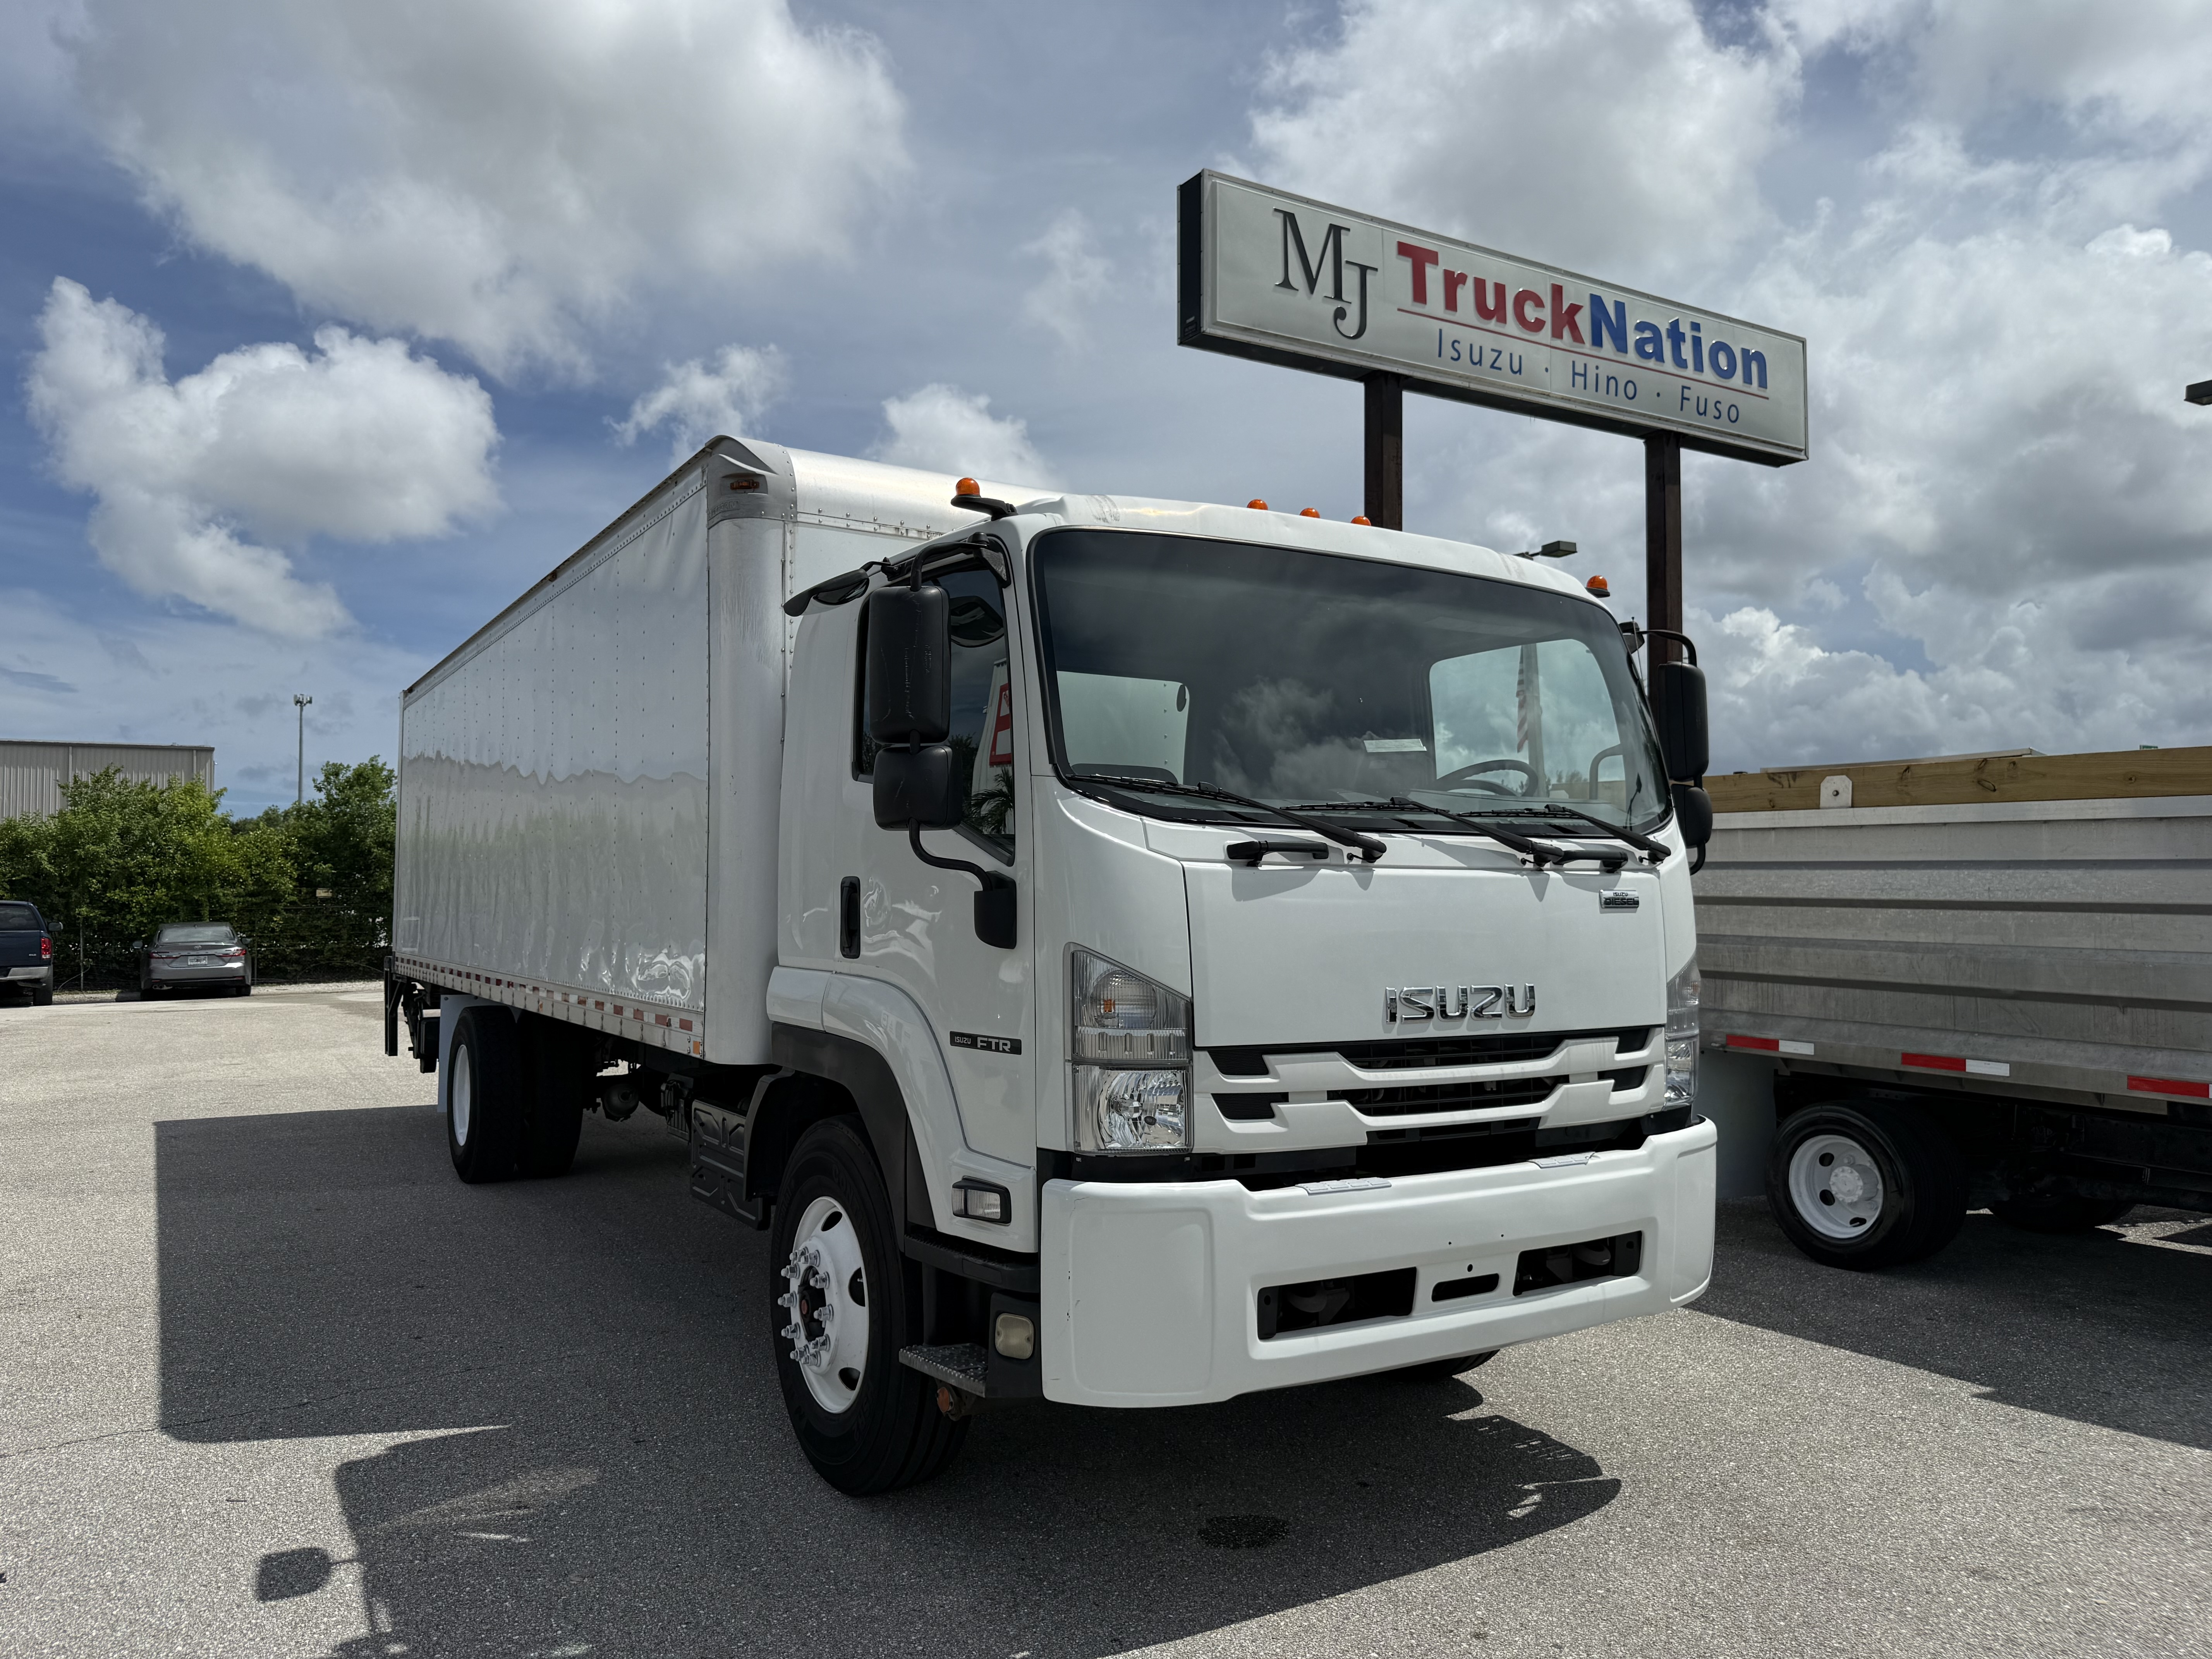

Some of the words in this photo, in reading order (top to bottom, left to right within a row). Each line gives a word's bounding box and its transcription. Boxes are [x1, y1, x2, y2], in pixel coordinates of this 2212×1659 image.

[1273, 208, 1378, 340] MJ
[1397, 241, 1767, 388] TruckNation
[1438, 328, 1522, 375] Isuzu
[1571, 359, 1637, 401] Hino
[1680, 385, 1739, 424] Fuso
[1604, 897, 1639, 905] DIESEL
[1386, 983, 1536, 1025] ISUZU
[955, 1036, 971, 1045] ISUZU
[977, 1036, 1011, 1052] FTR
